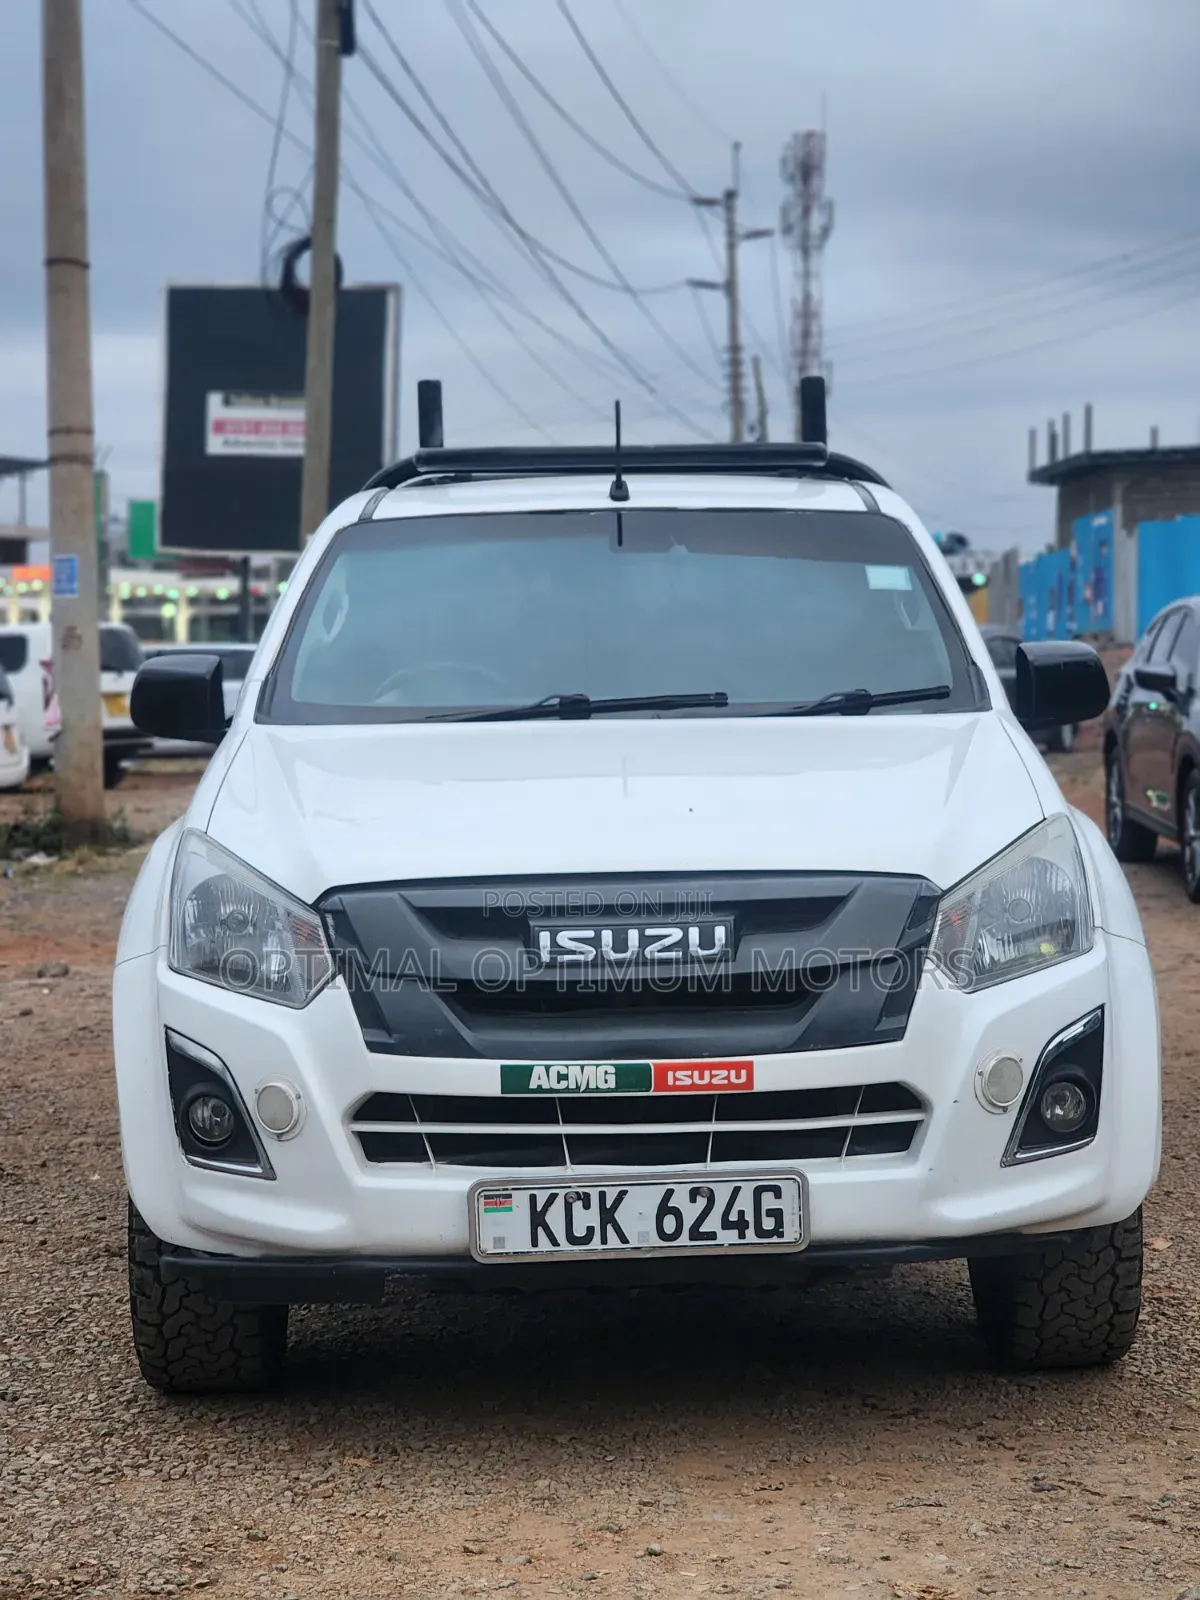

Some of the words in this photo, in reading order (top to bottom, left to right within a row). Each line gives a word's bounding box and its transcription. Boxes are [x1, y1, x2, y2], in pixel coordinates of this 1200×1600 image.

[538, 925, 726, 963] ISUZU
[529, 1065, 616, 1093] ACMG
[667, 1069, 747, 1086] ISUZU
[529, 1189, 631, 1247] KCK
[655, 1184, 785, 1243] 624G
